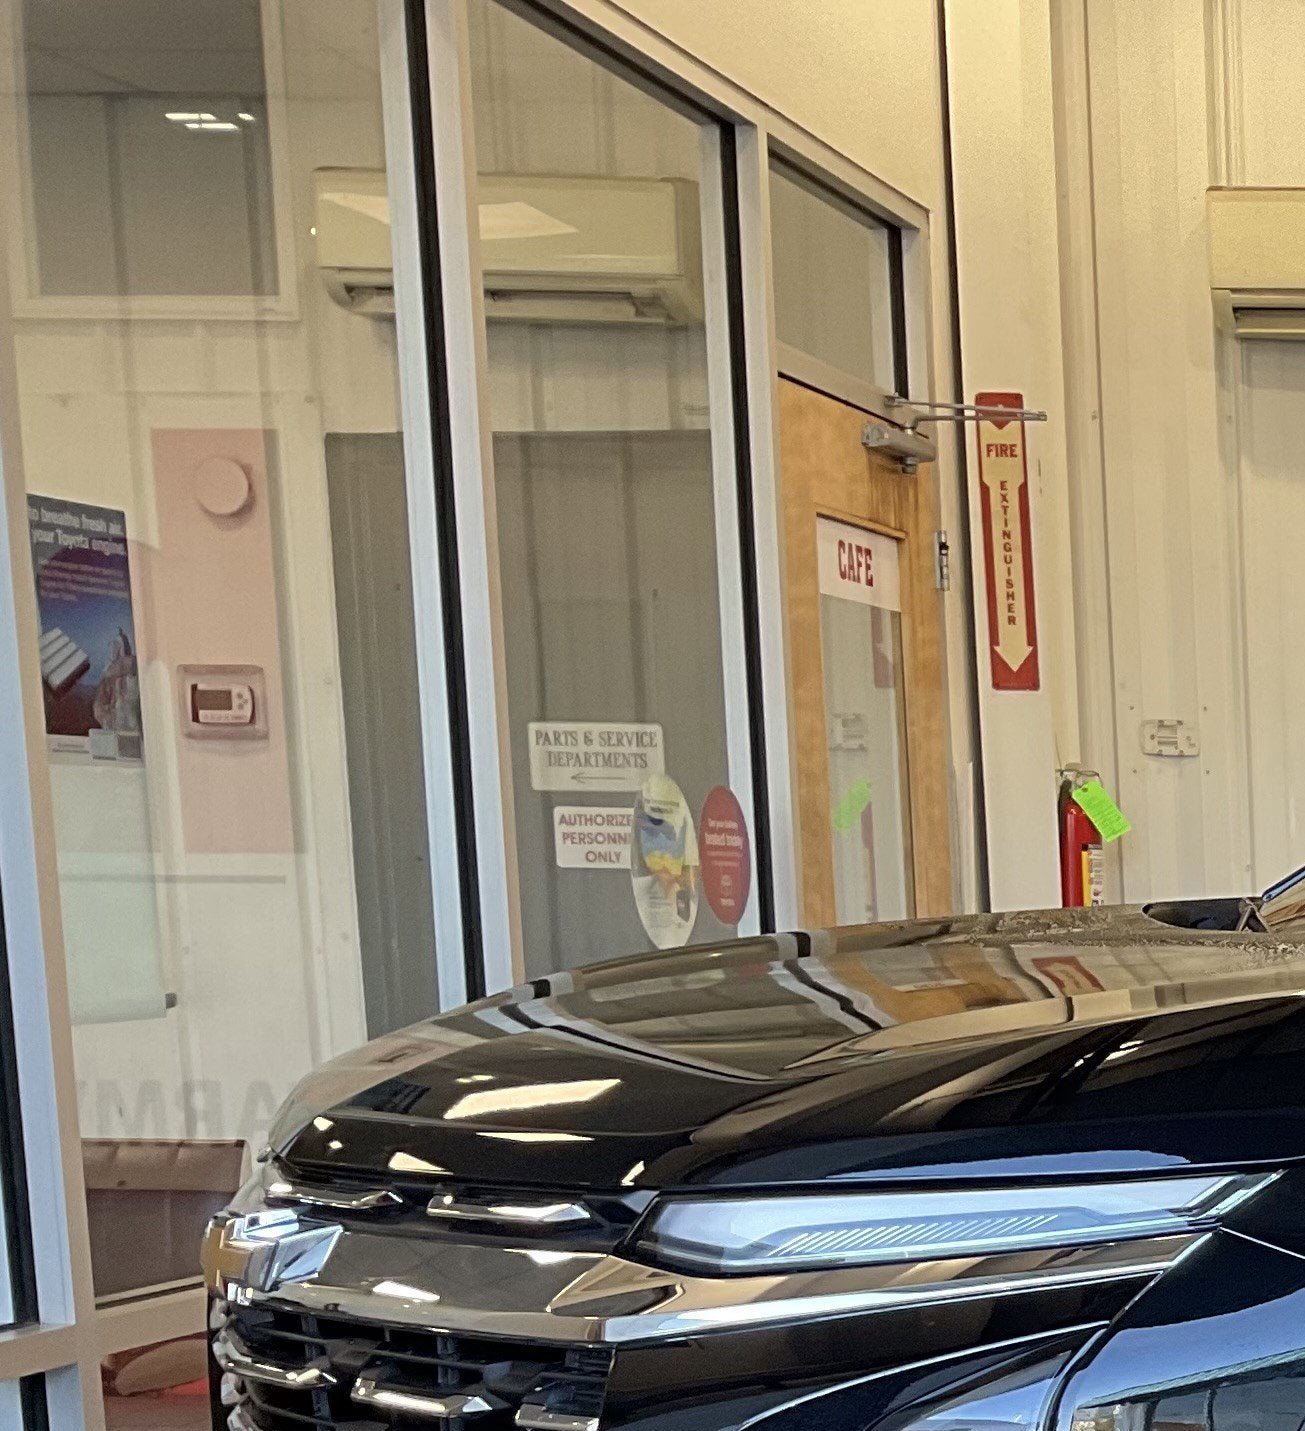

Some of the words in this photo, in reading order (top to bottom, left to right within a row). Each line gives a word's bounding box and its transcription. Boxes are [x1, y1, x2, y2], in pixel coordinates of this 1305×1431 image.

[985, 443, 1018, 458] FIRE
[999, 480, 1017, 626] EXTINGUISHER
[837, 539, 874, 588] CAFE
[535, 730, 578, 747] PARTS
[600, 731, 658, 748] SERVICE
[547, 751, 648, 769] DEPARTMENTS
[559, 813, 634, 826] AUTHORIZE
[585, 851, 622, 864] ONLY
